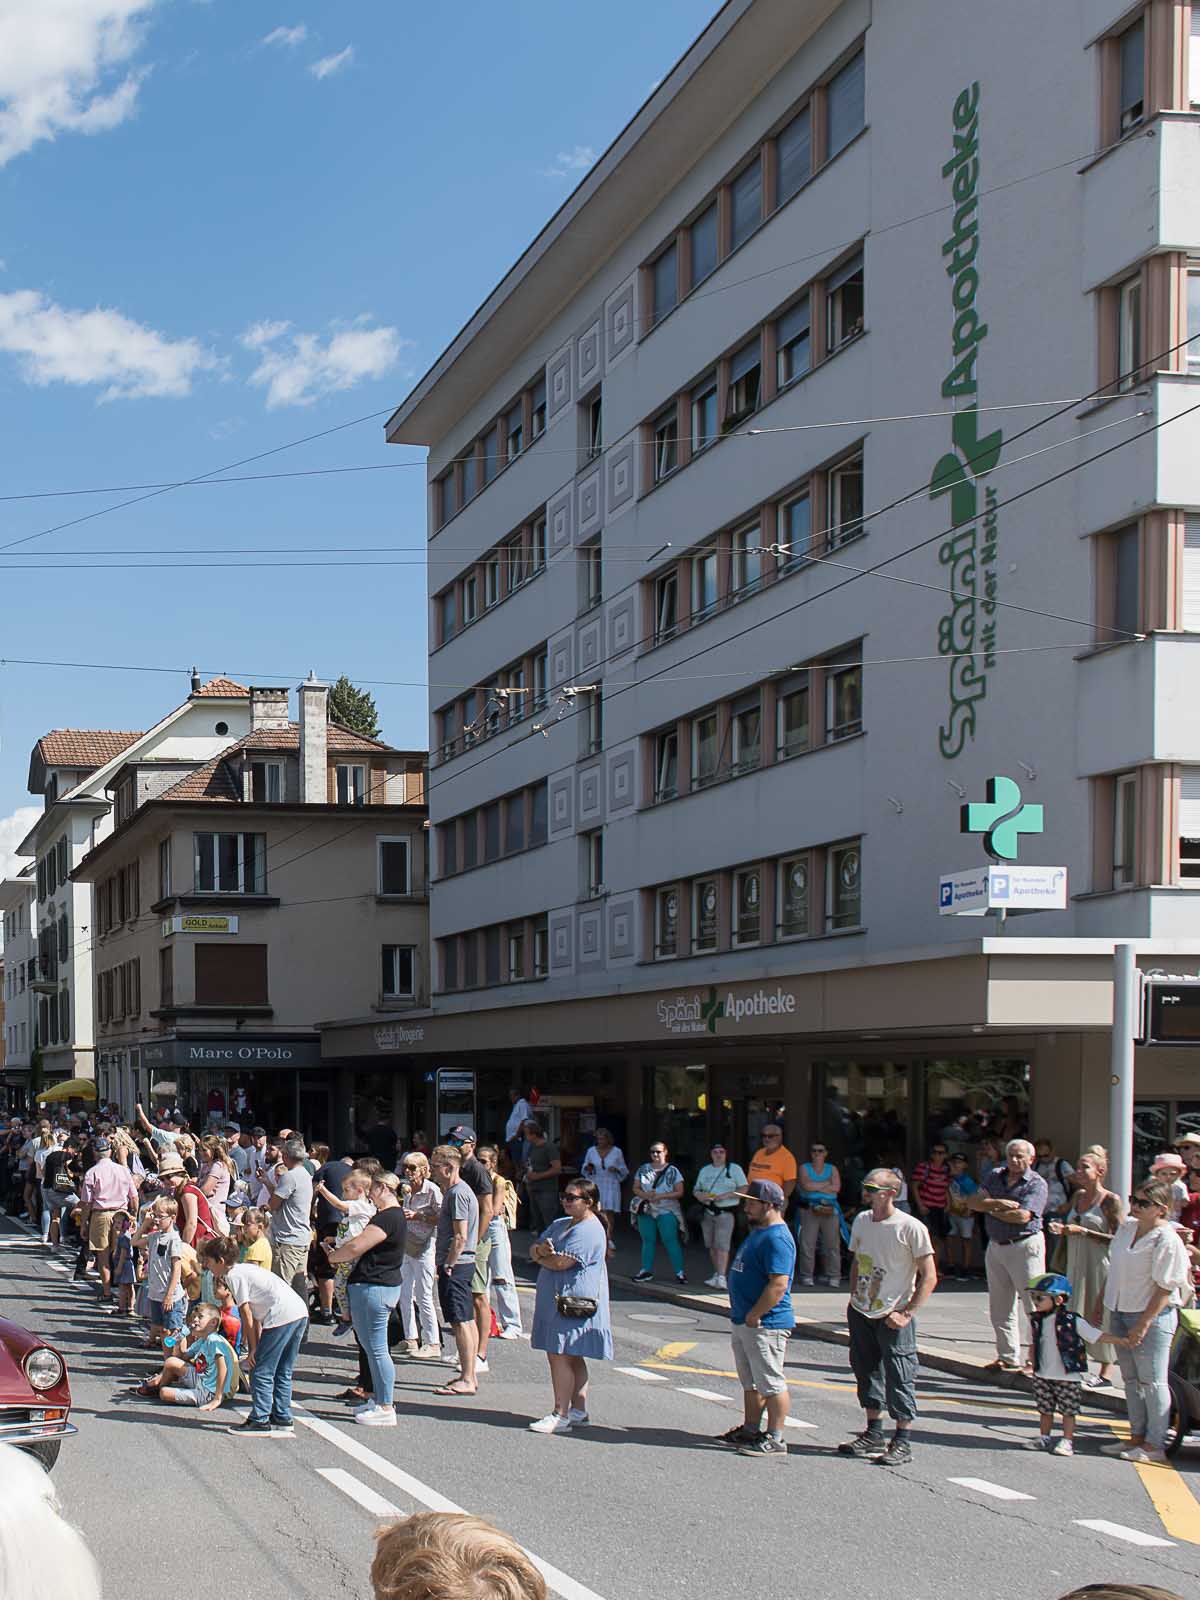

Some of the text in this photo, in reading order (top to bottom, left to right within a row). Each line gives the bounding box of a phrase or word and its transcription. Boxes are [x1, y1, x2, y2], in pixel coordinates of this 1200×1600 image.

[937, 79, 989, 760] Späni Apotheke
[980, 485, 998, 669] mit der Natur
[954, 889, 984, 899] Apotheke
[1014, 886, 1056, 896] Apotheke
[185, 919, 208, 927] GOLD
[656, 987, 796, 1029] Späni Apotheke
[189, 1047, 293, 1059] Marc O'Polo
